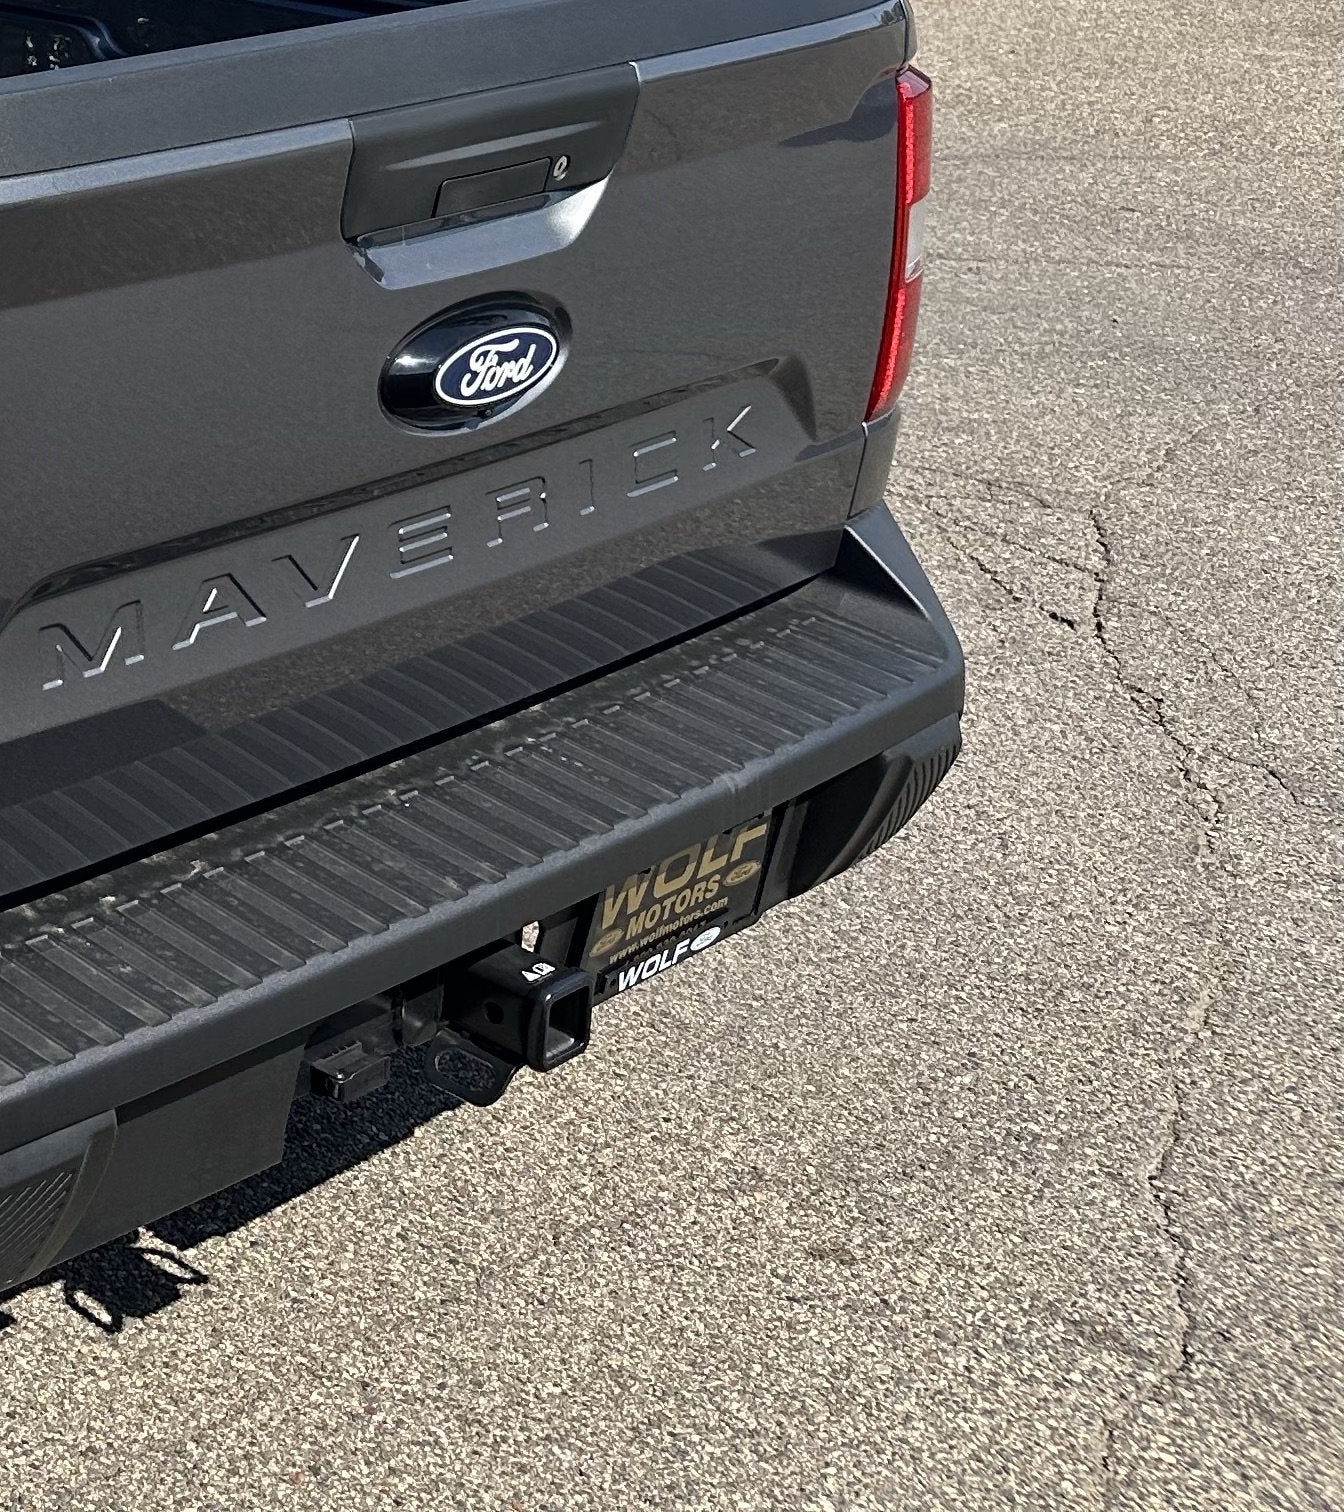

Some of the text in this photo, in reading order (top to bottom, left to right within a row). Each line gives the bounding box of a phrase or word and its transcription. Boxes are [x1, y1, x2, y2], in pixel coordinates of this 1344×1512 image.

[460, 338, 536, 397] Ford
[38, 405, 757, 689] MAVERICK
[600, 822, 768, 930] WOLF
[625, 873, 721, 941] MOTORS
[618, 937, 691, 992] WOLF
